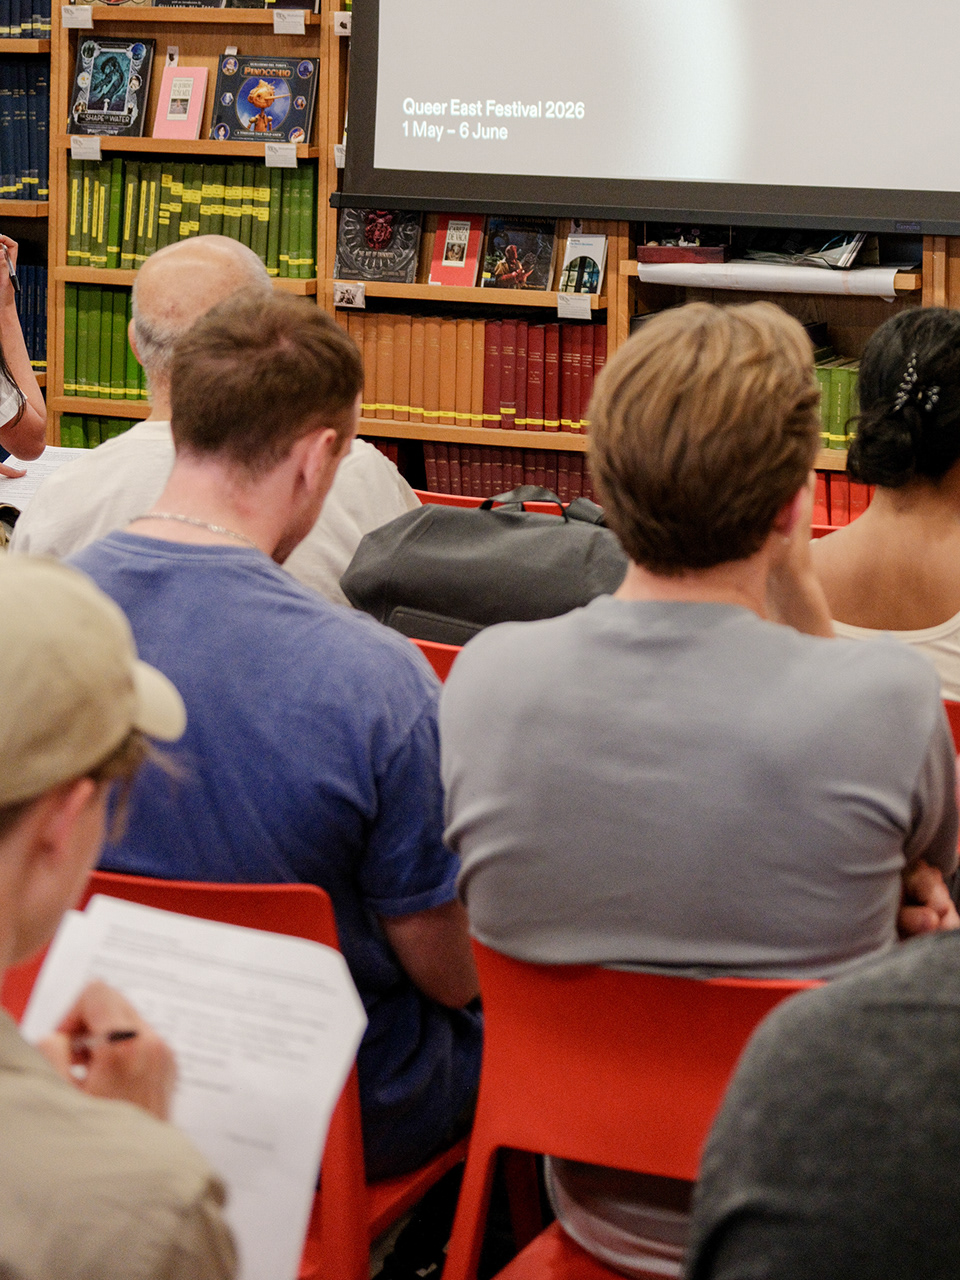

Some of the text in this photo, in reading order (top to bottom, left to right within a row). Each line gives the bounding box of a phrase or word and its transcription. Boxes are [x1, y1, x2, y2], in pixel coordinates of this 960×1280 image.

[244, 66, 291, 77] PINOCCHIO
[403, 97, 586, 119] Queer East Festival 2026
[110, 115, 130, 123] WATER
[402, 120, 409, 137] 1
[412, 121, 444, 142] May
[459, 121, 470, 139] 6
[472, 122, 509, 140] June
